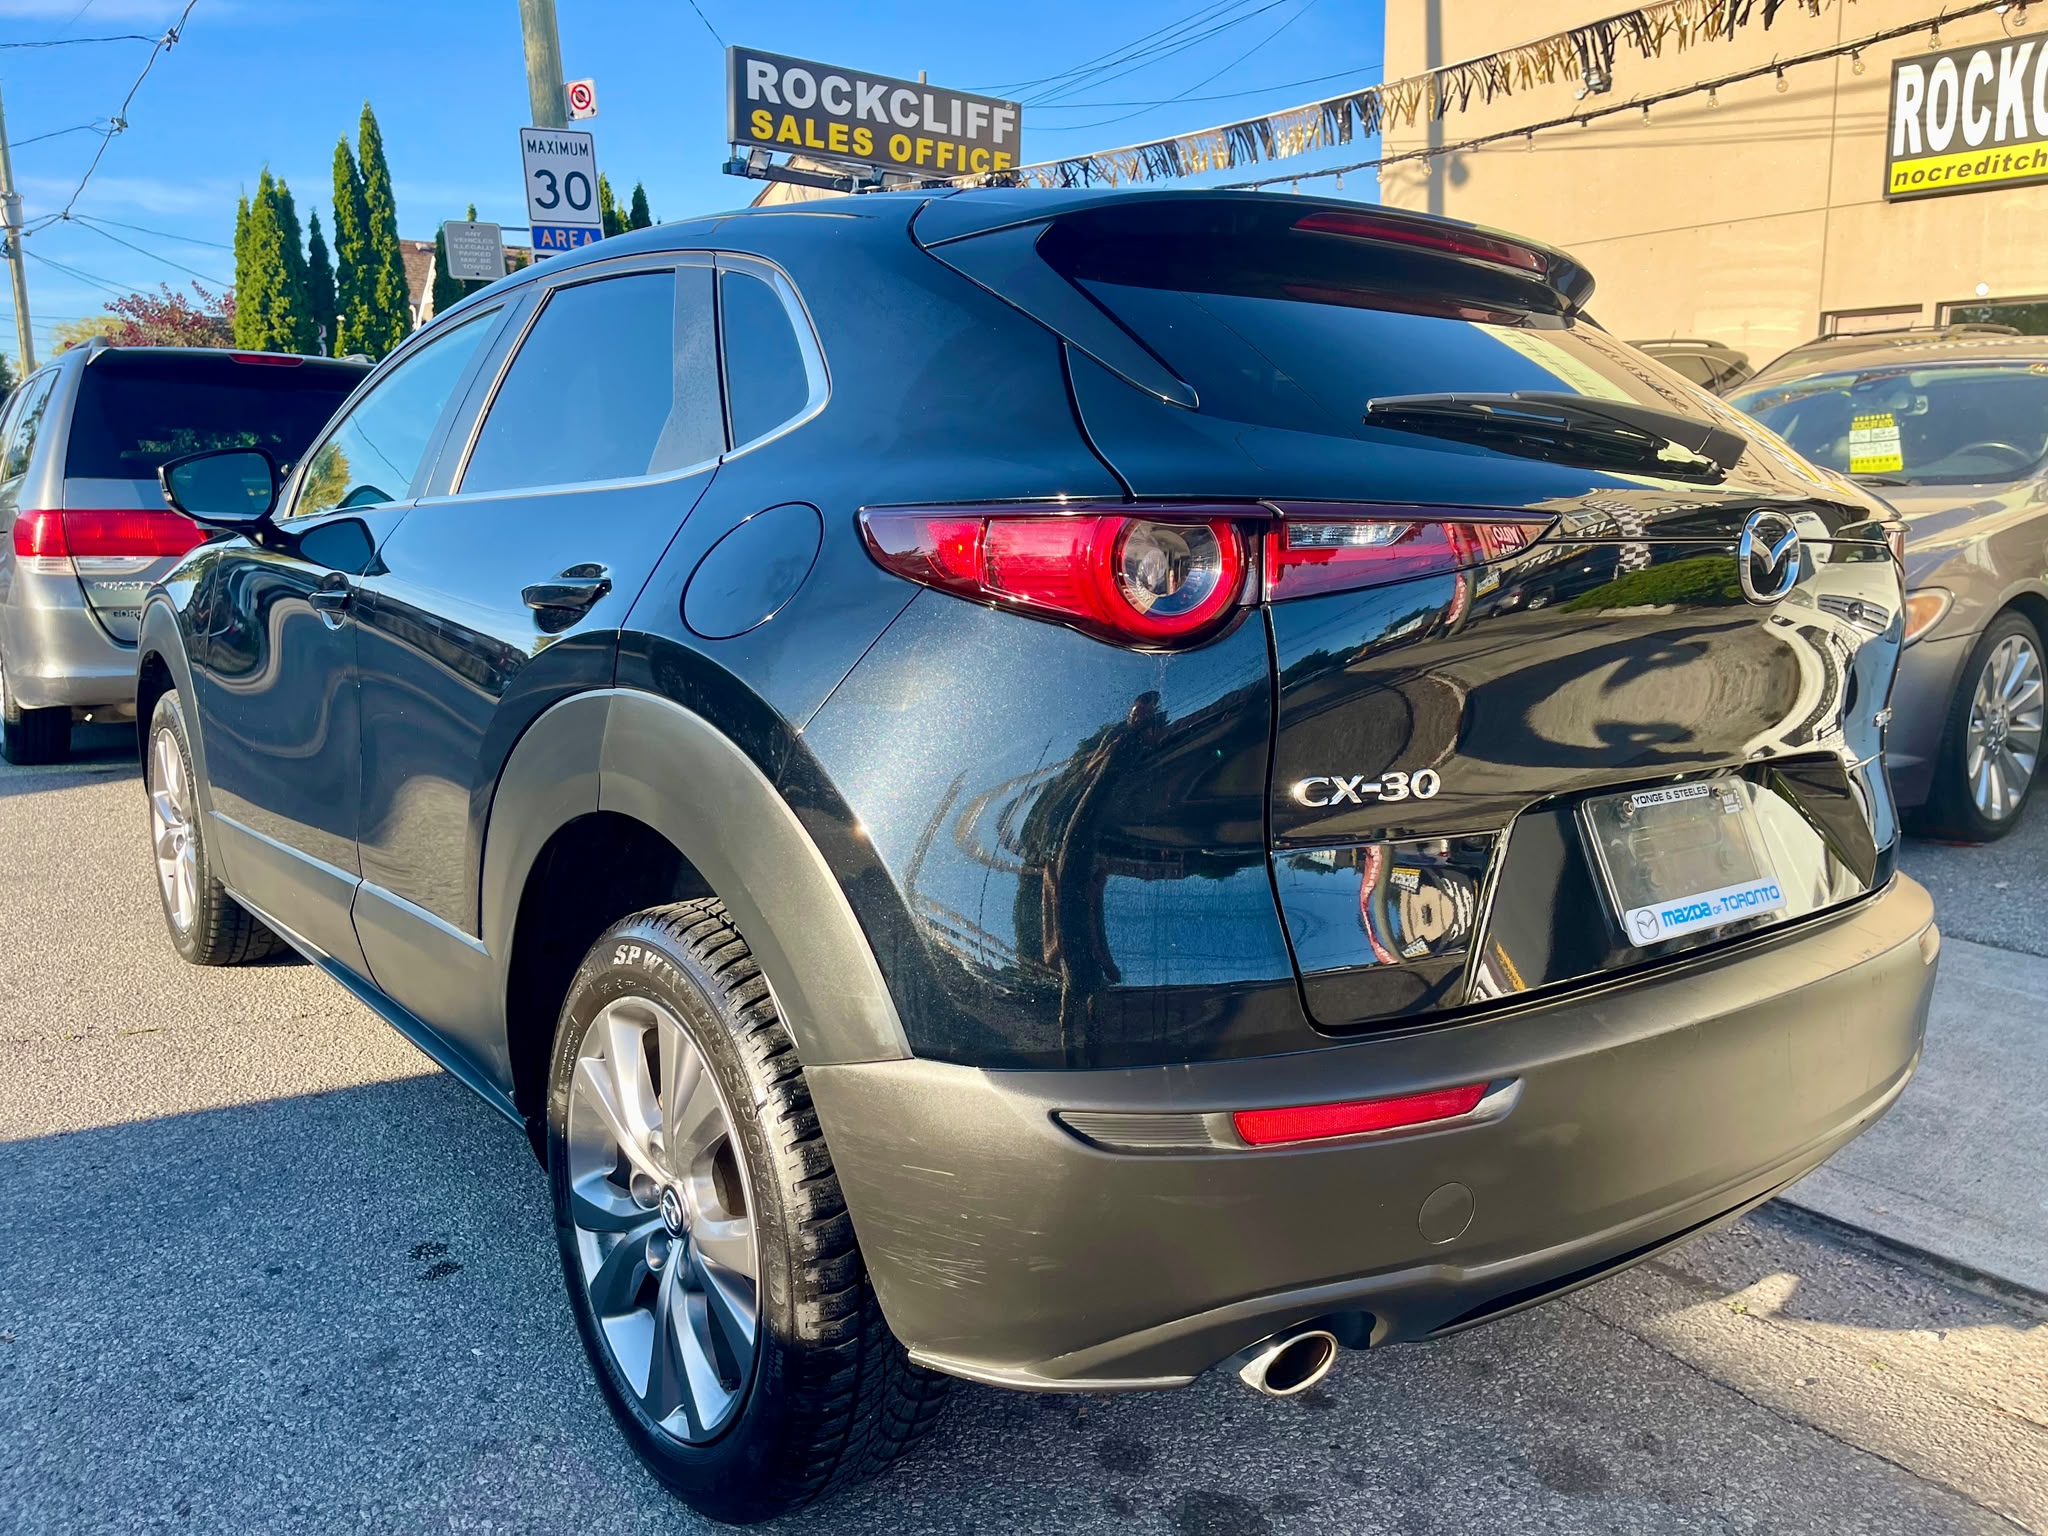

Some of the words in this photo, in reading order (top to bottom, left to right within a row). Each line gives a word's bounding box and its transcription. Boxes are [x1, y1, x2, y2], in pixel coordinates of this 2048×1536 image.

[745, 58, 1016, 144] ROCKCLIFF
[527, 139, 589, 157] MAXIMUM
[750, 109, 874, 157] SALES
[888, 133, 1012, 174] OFFICE
[1894, 148, 2048, 187] nocreditch
[534, 169, 592, 211] 30
[453, 243, 495, 251] ILLEGALLY
[541, 229, 593, 249] AREA
[1293, 768, 1441, 807] CX-30
[1633, 791, 1664, 805] YONGE
[1666, 791, 1671, 801] &
[1673, 785, 1709, 799] STEELES
[1720, 885, 1780, 912] TORONTO
[613, 944, 642, 965] SP
